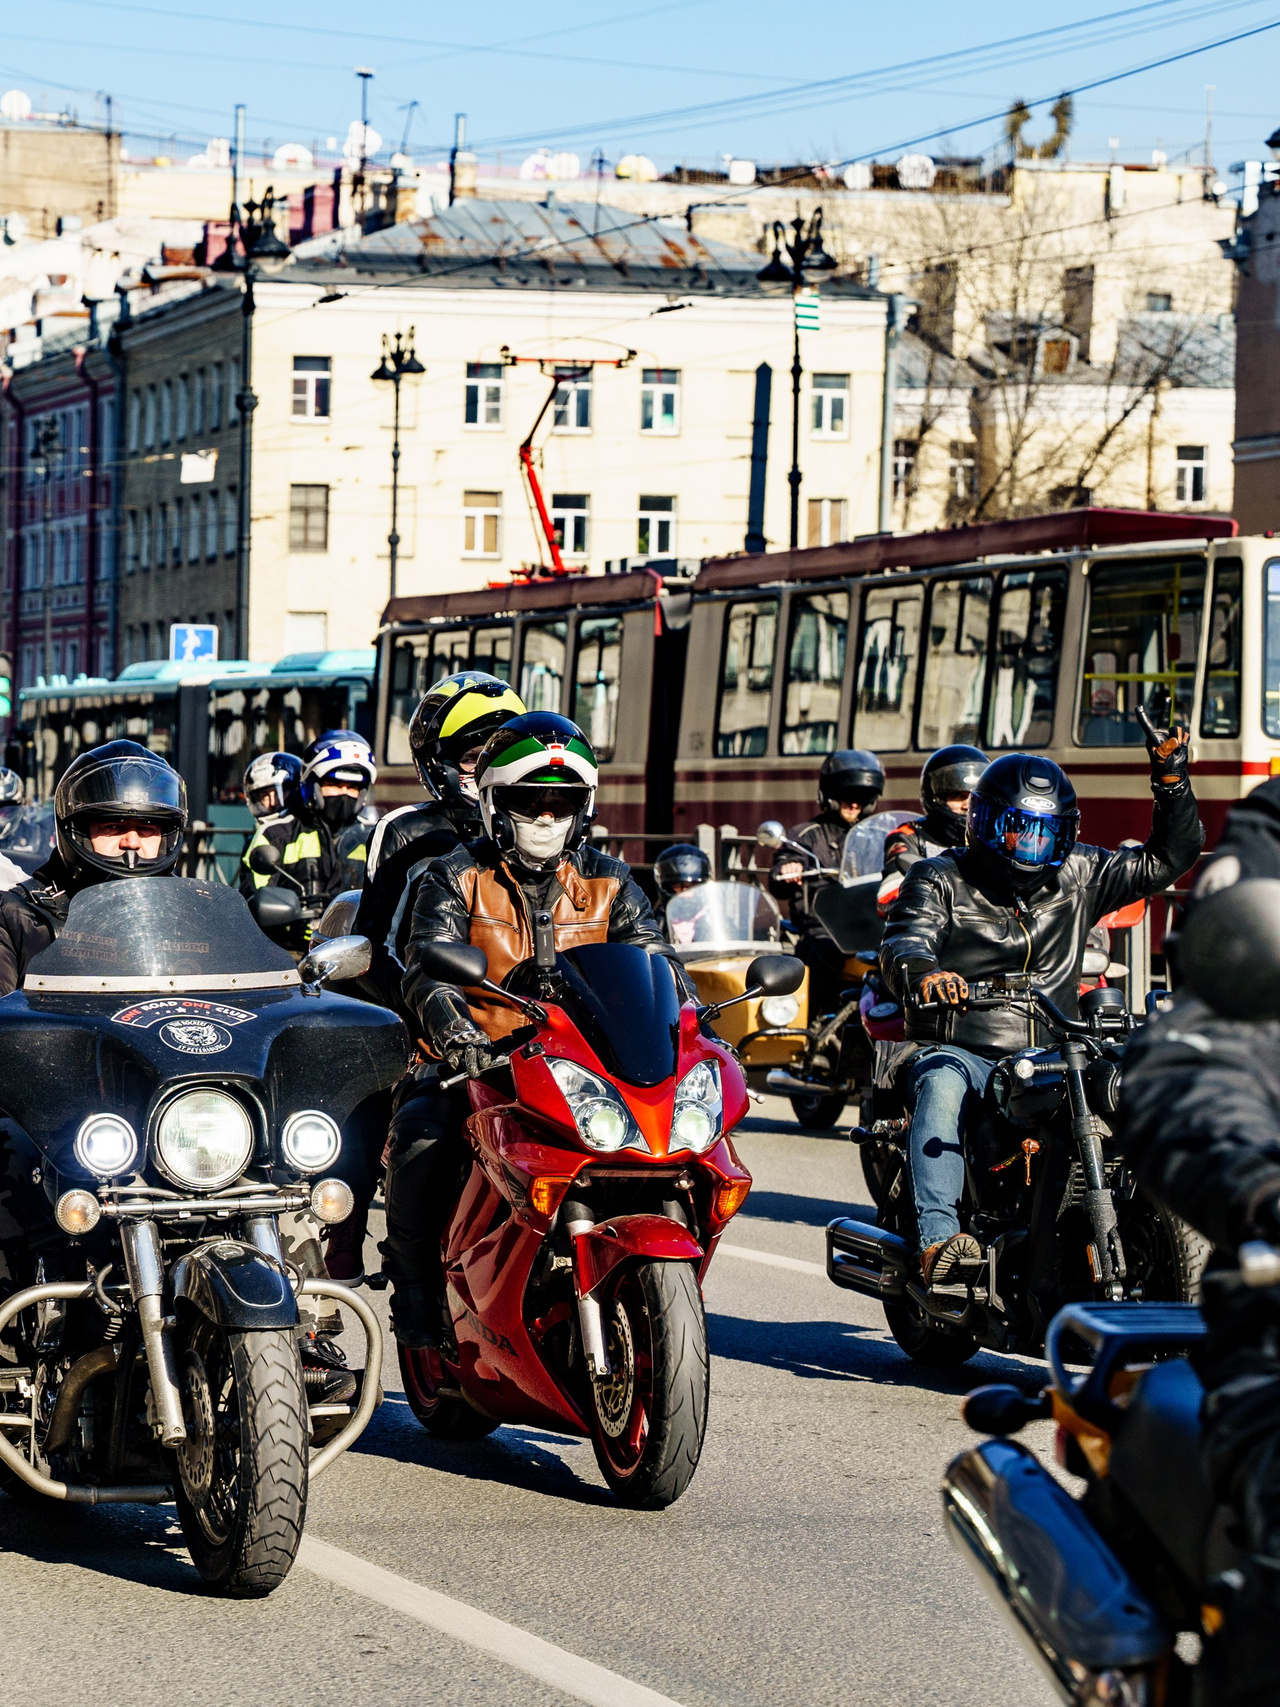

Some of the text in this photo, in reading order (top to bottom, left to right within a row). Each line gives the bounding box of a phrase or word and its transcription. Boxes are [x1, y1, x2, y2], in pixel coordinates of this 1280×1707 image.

[120, 1001, 249, 1023] ONE ROAD ONE CLUB
